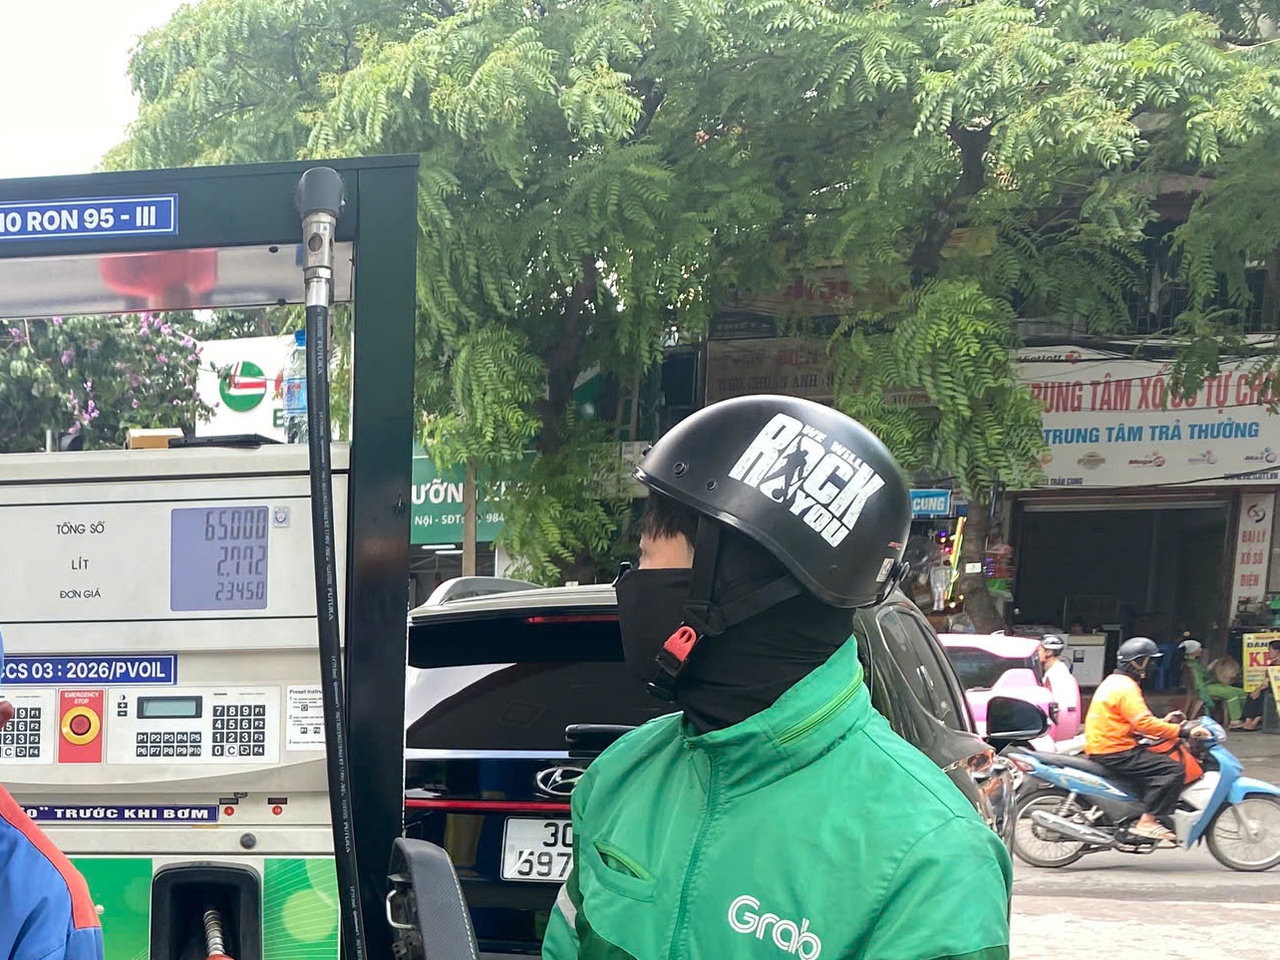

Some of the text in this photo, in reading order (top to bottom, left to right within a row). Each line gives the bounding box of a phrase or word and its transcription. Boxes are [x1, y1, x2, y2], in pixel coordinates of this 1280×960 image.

[26, 211, 80, 233] RON
[83, 209, 115, 230] 95
[135, 206, 157, 228] III
[1028, 381, 1083, 413] RUNG
[1090, 373, 1132, 411] TÂM
[802, 424, 827, 443] WE
[1043, 417, 1260, 445] TRUNG TÂM TRẢ THƯỞNG
[728, 412, 886, 530] ROCK
[412, 478, 465, 504] ƯỠN
[913, 496, 945, 511] CUNG
[205, 509, 267, 541] 65000
[789, 490, 850, 548] YOU
[56, 520, 106, 535] TỔNG SỐ
[71, 556, 89, 570] LÍT
[60, 587, 102, 600] ĐƠN GIÁ
[215, 581, 265, 601] 23450
[326, 587, 334, 621] FUTURA
[32, 662, 53, 678] 03
[66, 661, 166, 680] 2026/PVOIL
[20, 710, 26, 718] 9
[216, 707, 222, 715] 7
[229, 706, 235, 715] 8
[242, 706, 249, 715] 9
[6, 722, 12, 730] 5
[19, 722, 25, 730] 6
[215, 720, 221, 729] 4
[228, 720, 235, 729] 5
[242, 720, 249, 729] 6
[6, 735, 12, 743] 2
[18, 735, 25, 743] 3
[228, 733, 235, 742] 2
[242, 733, 248, 742] 3
[5, 748, 12, 756] C
[214, 746, 221, 755] 0
[228, 746, 235, 755] C
[54, 807, 118, 818] TRƯỚC
[124, 808, 160, 818] KHI
[164, 808, 208, 819] BƠM
